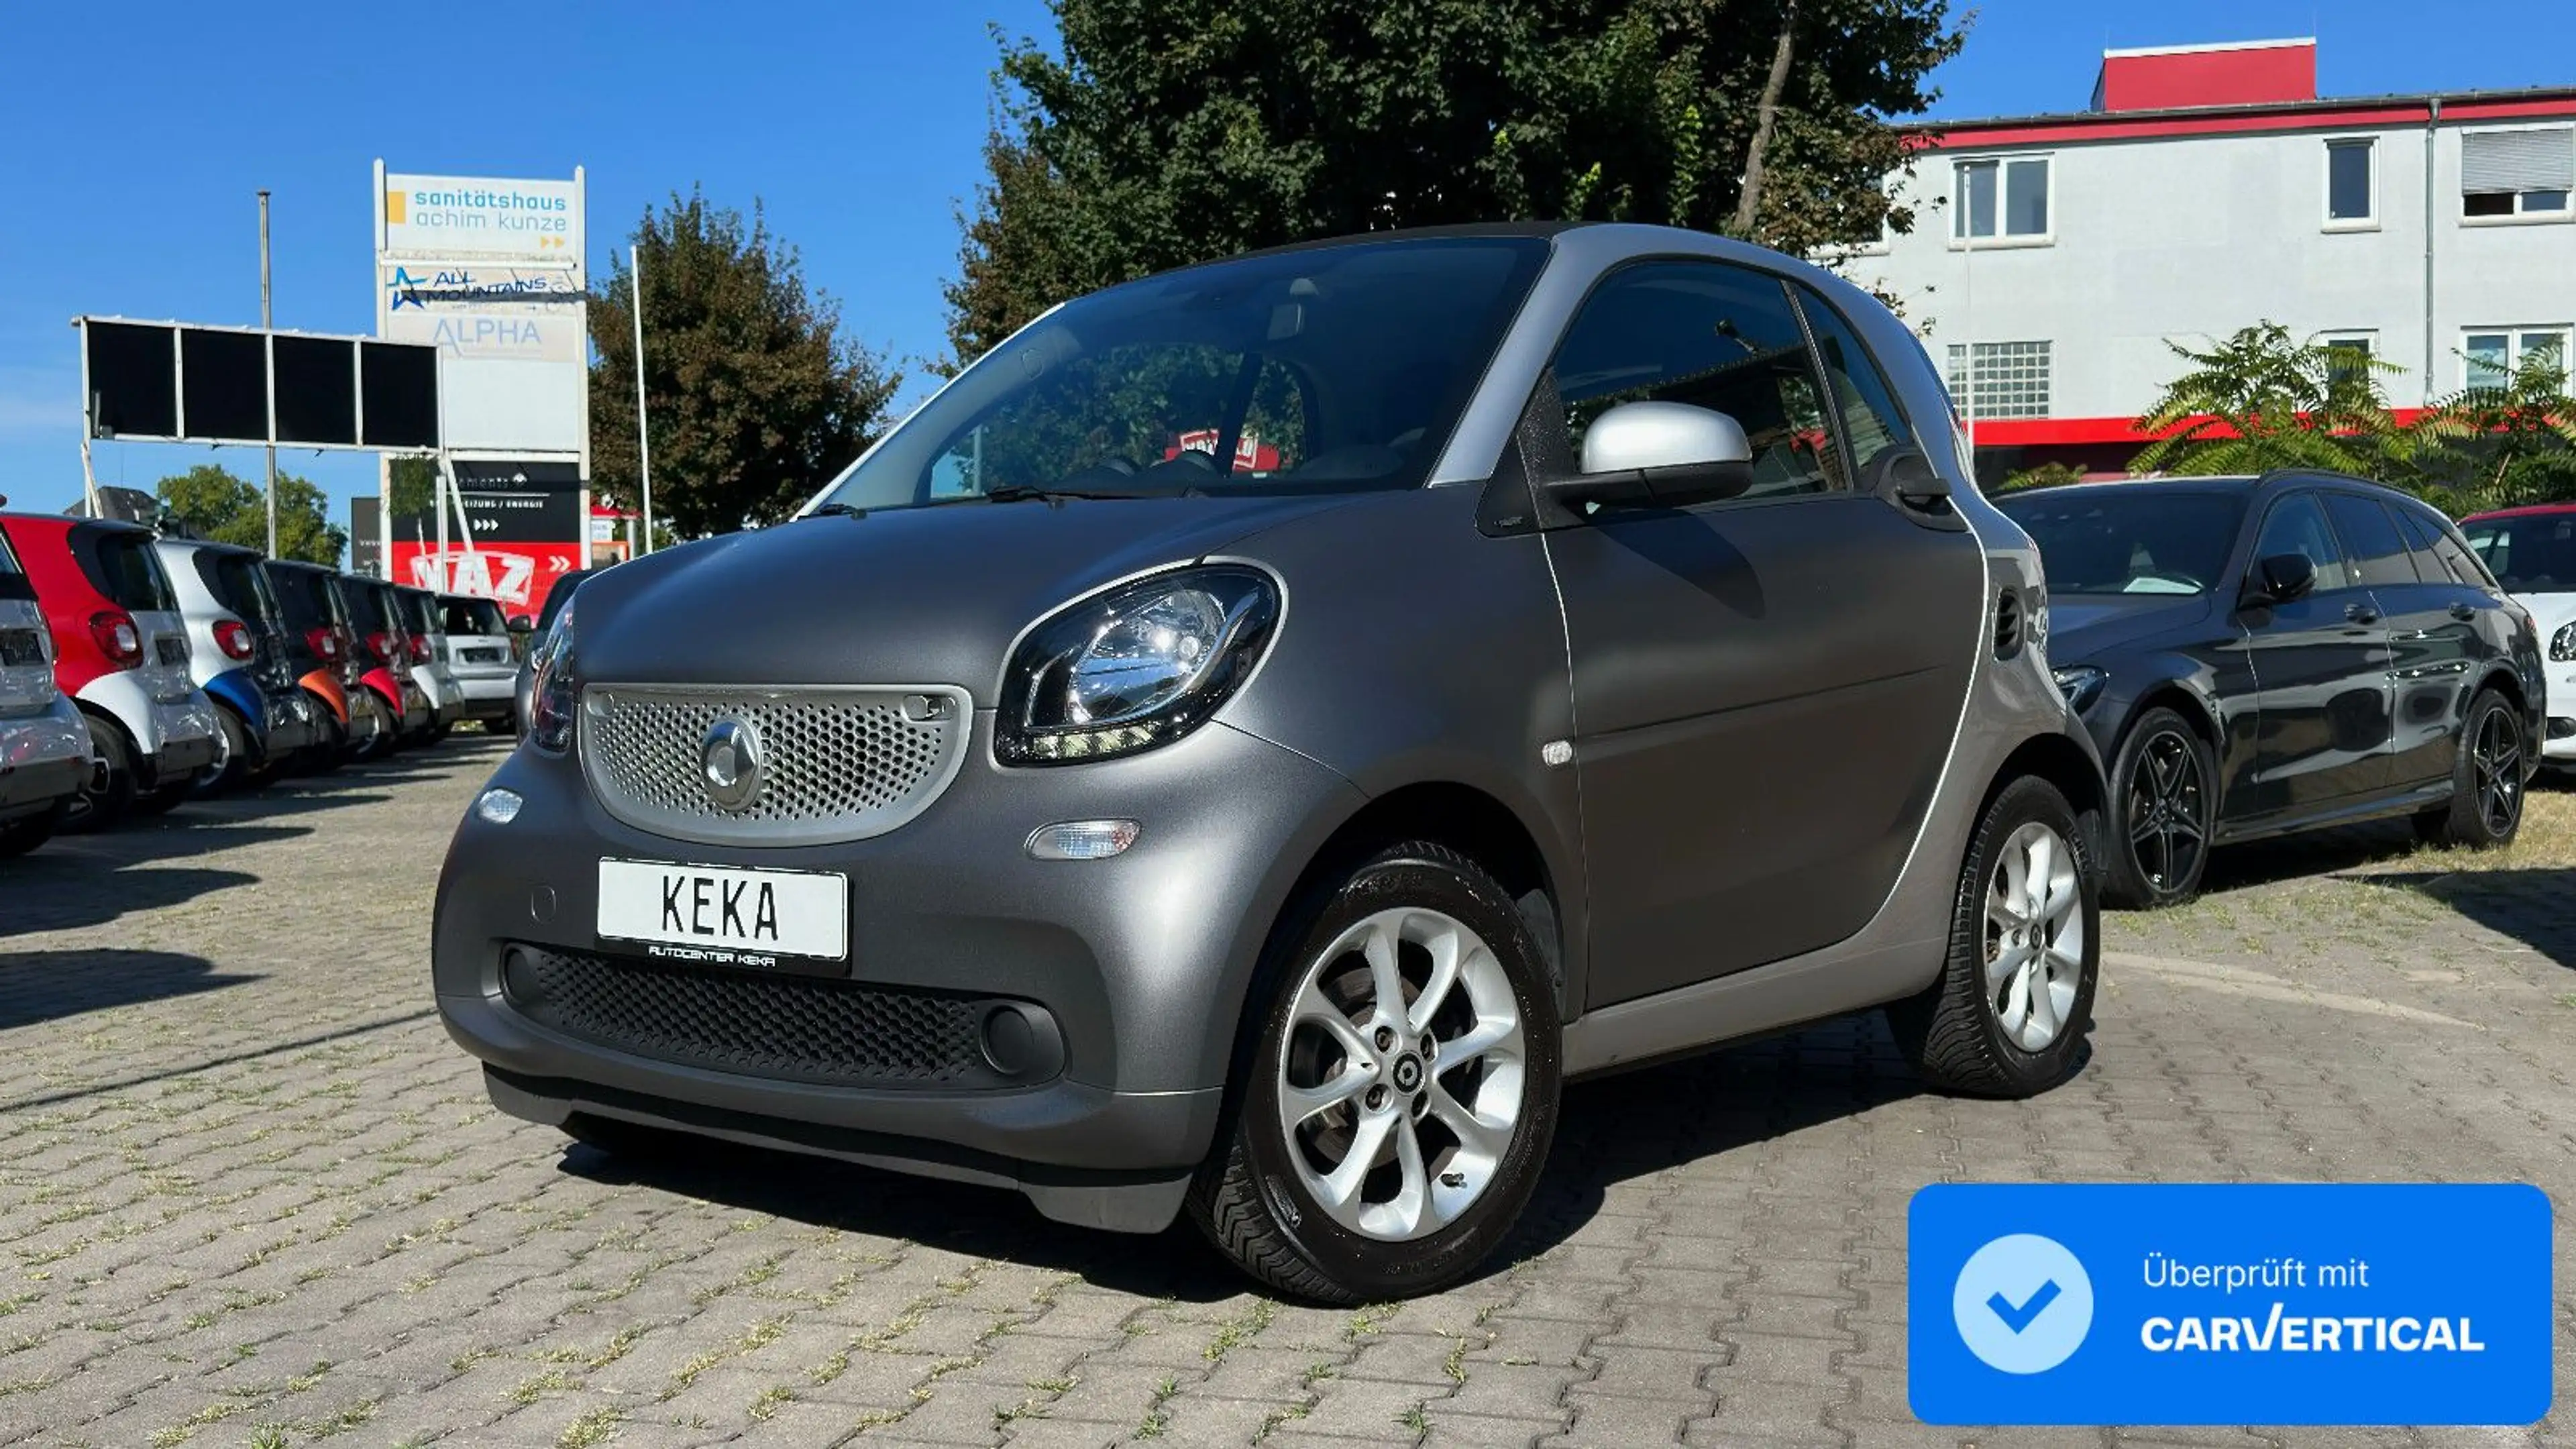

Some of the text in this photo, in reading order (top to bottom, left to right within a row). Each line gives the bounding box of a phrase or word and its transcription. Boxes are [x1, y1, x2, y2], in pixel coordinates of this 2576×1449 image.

[415, 189, 566, 211] sanitätshaus
[416, 209, 566, 232] achim kunze
[433, 270, 477, 287] ALL
[426, 277, 547, 304] MOUNTAINS
[433, 317, 541, 347] ALPHA
[463, 499, 496, 508] EIZUNG
[661, 875, 779, 941] KEKA
[648, 946, 776, 967] AUTOCENTER KEKA
